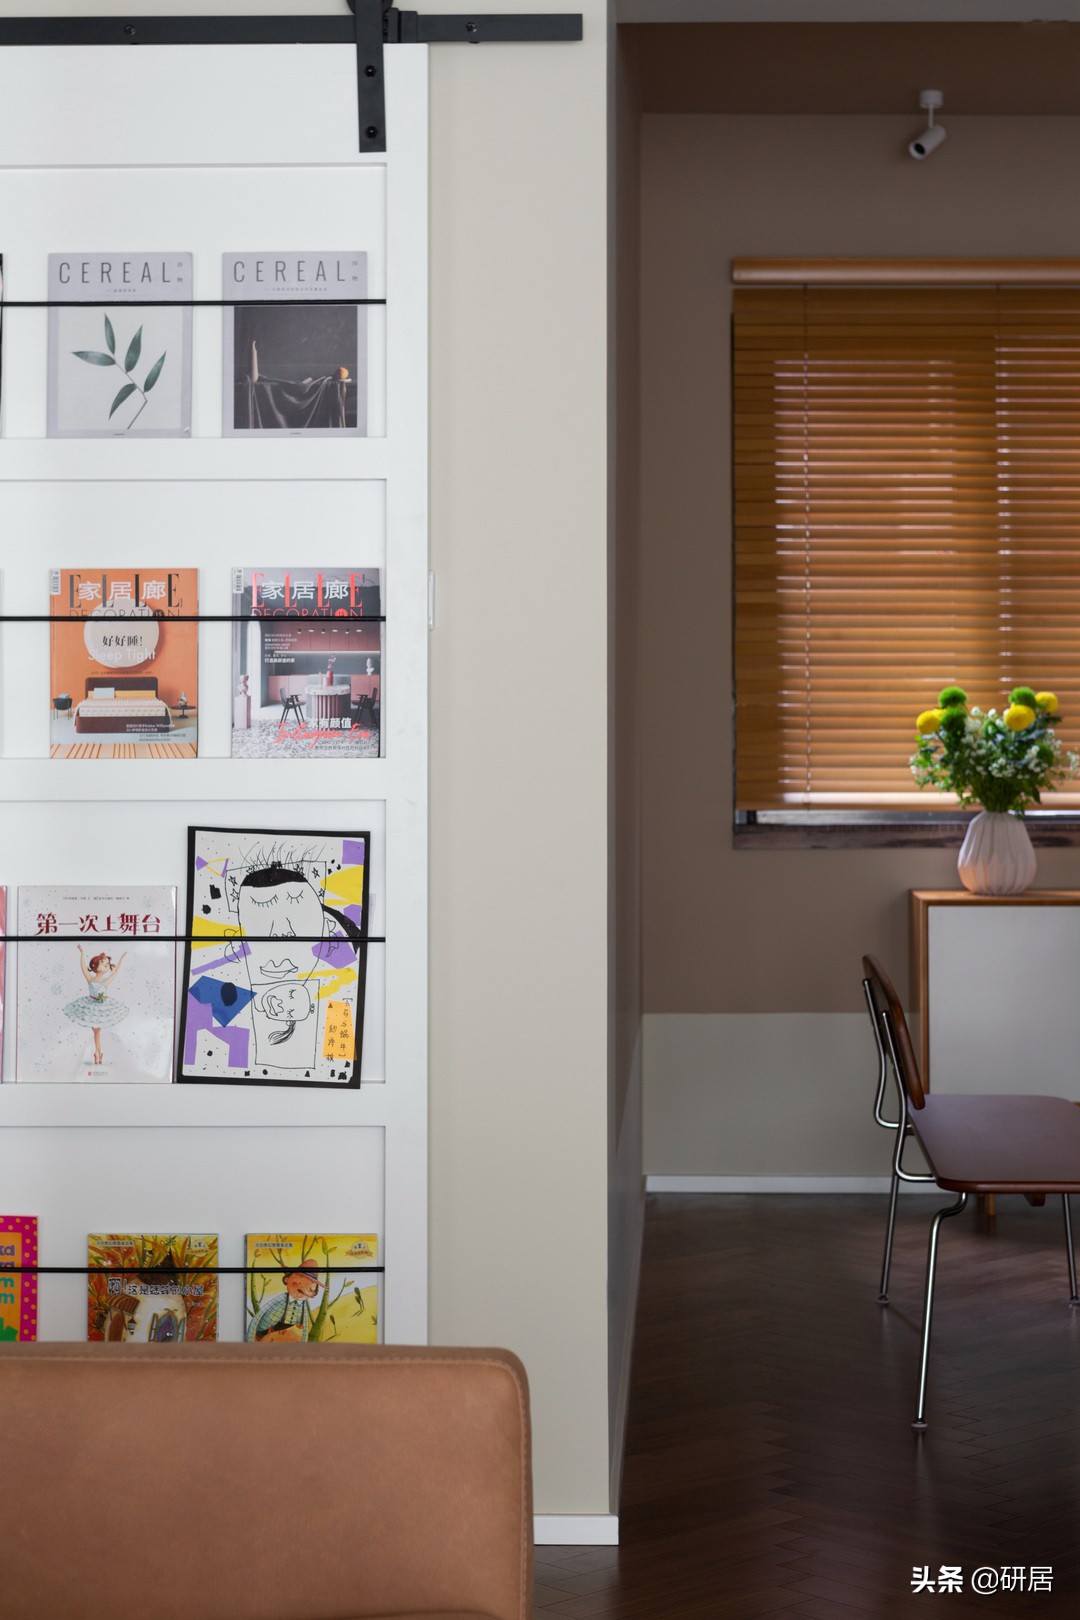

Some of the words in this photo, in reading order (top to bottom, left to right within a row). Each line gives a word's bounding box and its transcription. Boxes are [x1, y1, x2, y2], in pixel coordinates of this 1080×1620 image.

[59, 262, 171, 284] CEREAL
[233, 260, 346, 283] CEREAL
[69, 573, 180, 608] ELLE
[78, 580, 167, 600] 家居廊
[250, 573, 363, 608] ELLE
[261, 580, 350, 600] 家居廊
[88, 648, 122, 662] Sleep
[126, 648, 157, 662] Tight
[35, 912, 161, 936] 第一次上舞台
